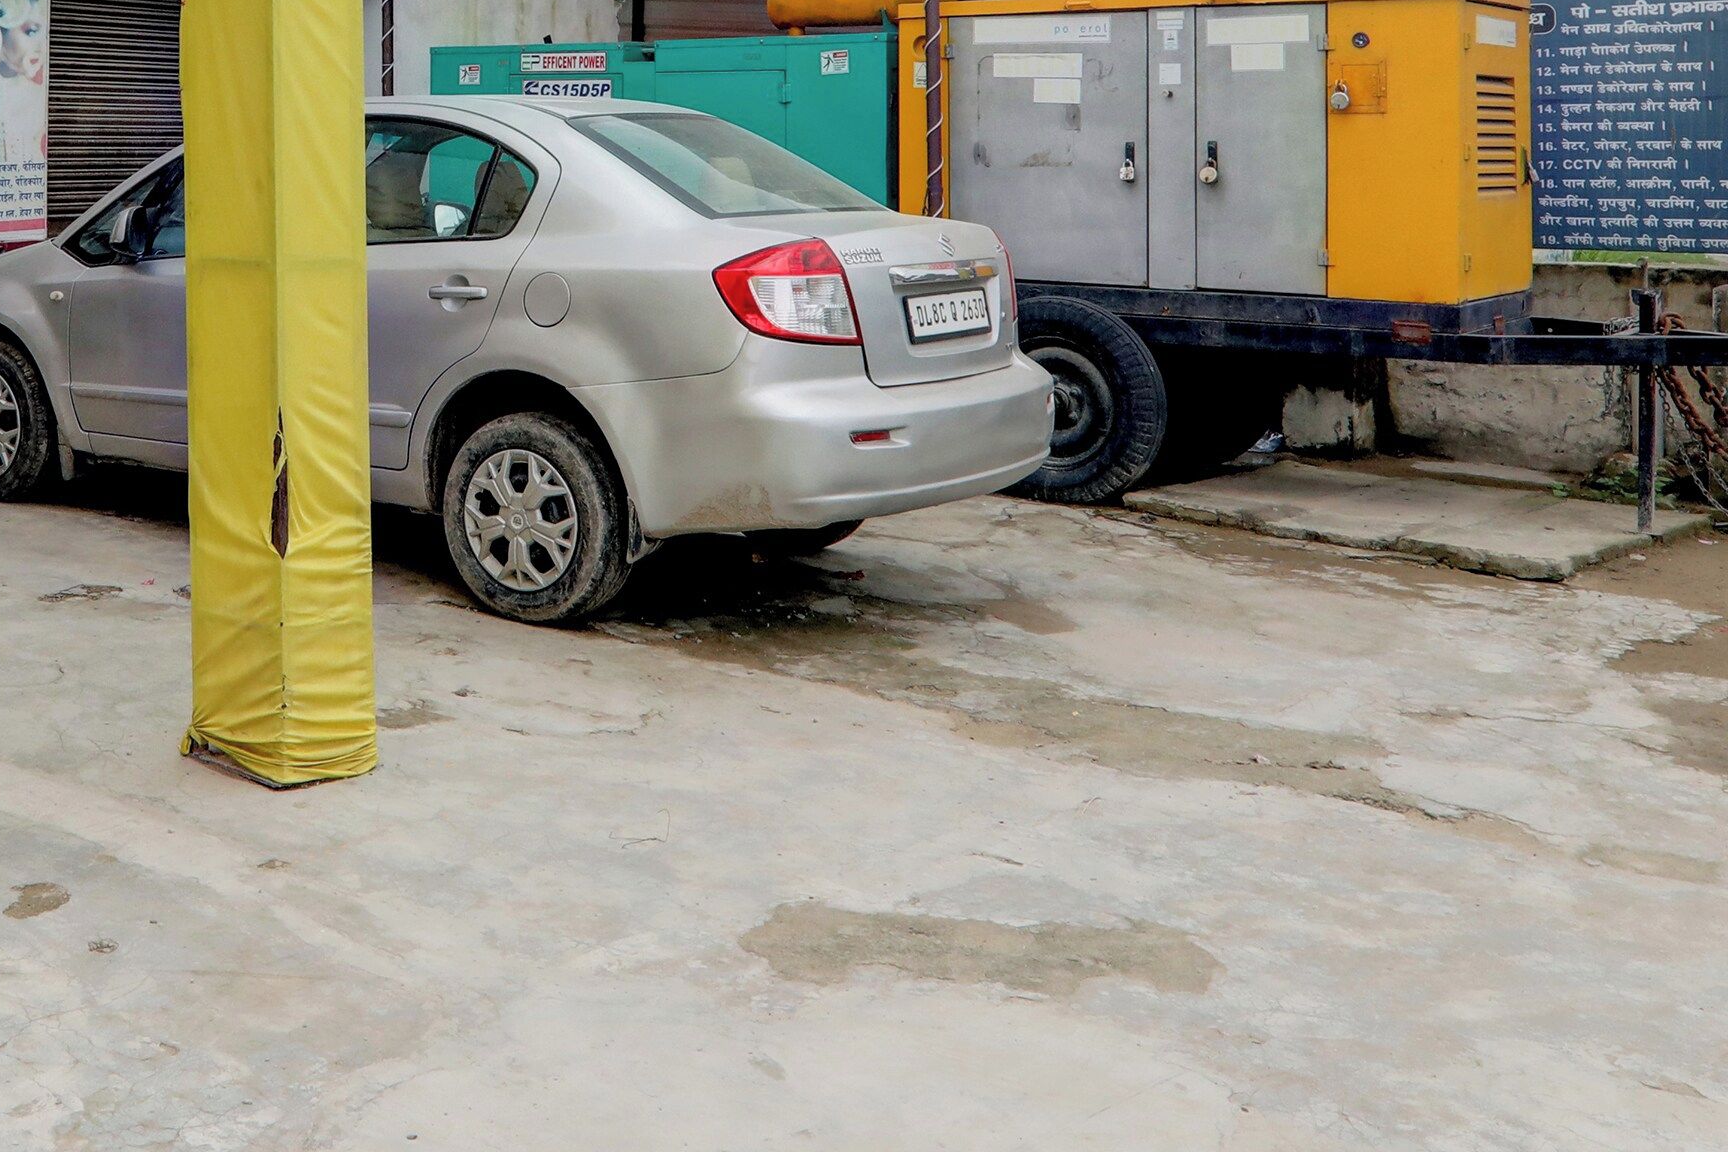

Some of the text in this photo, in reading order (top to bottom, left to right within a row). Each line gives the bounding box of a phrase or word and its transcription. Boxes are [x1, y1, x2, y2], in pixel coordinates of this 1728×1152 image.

[1612, 0, 1665, 17] सतीश
[1536, 48, 1555, 58] 11.
[542, 55, 577, 70] EFFICENT
[579, 55, 606, 69] POWER
[1537, 60, 1672, 77] 12. मेन गेट डेकोरेशन के
[540, 83, 610, 98] CS15D5P
[1537, 80, 1664, 96] 13. मण्डप डेकोरेशन के
[1537, 104, 1556, 114] 14.
[1641, 99, 1665, 111] और
[1538, 120, 1612, 133] 15. की
[1538, 137, 1722, 151] 16. के साथ
[1538, 157, 1677, 170] 17. CCTV की निगरानी
[1539, 178, 1585, 189] 18. पान
[1539, 213, 1694, 229] और खाना इत्यादि की उत्तम
[1541, 232, 1697, 251] 19. कॉफी मशीन की सुविधा
[843, 253, 884, 265] SUZUKI
[916, 299, 947, 327] DL8C
[952, 300, 958, 321] Q
